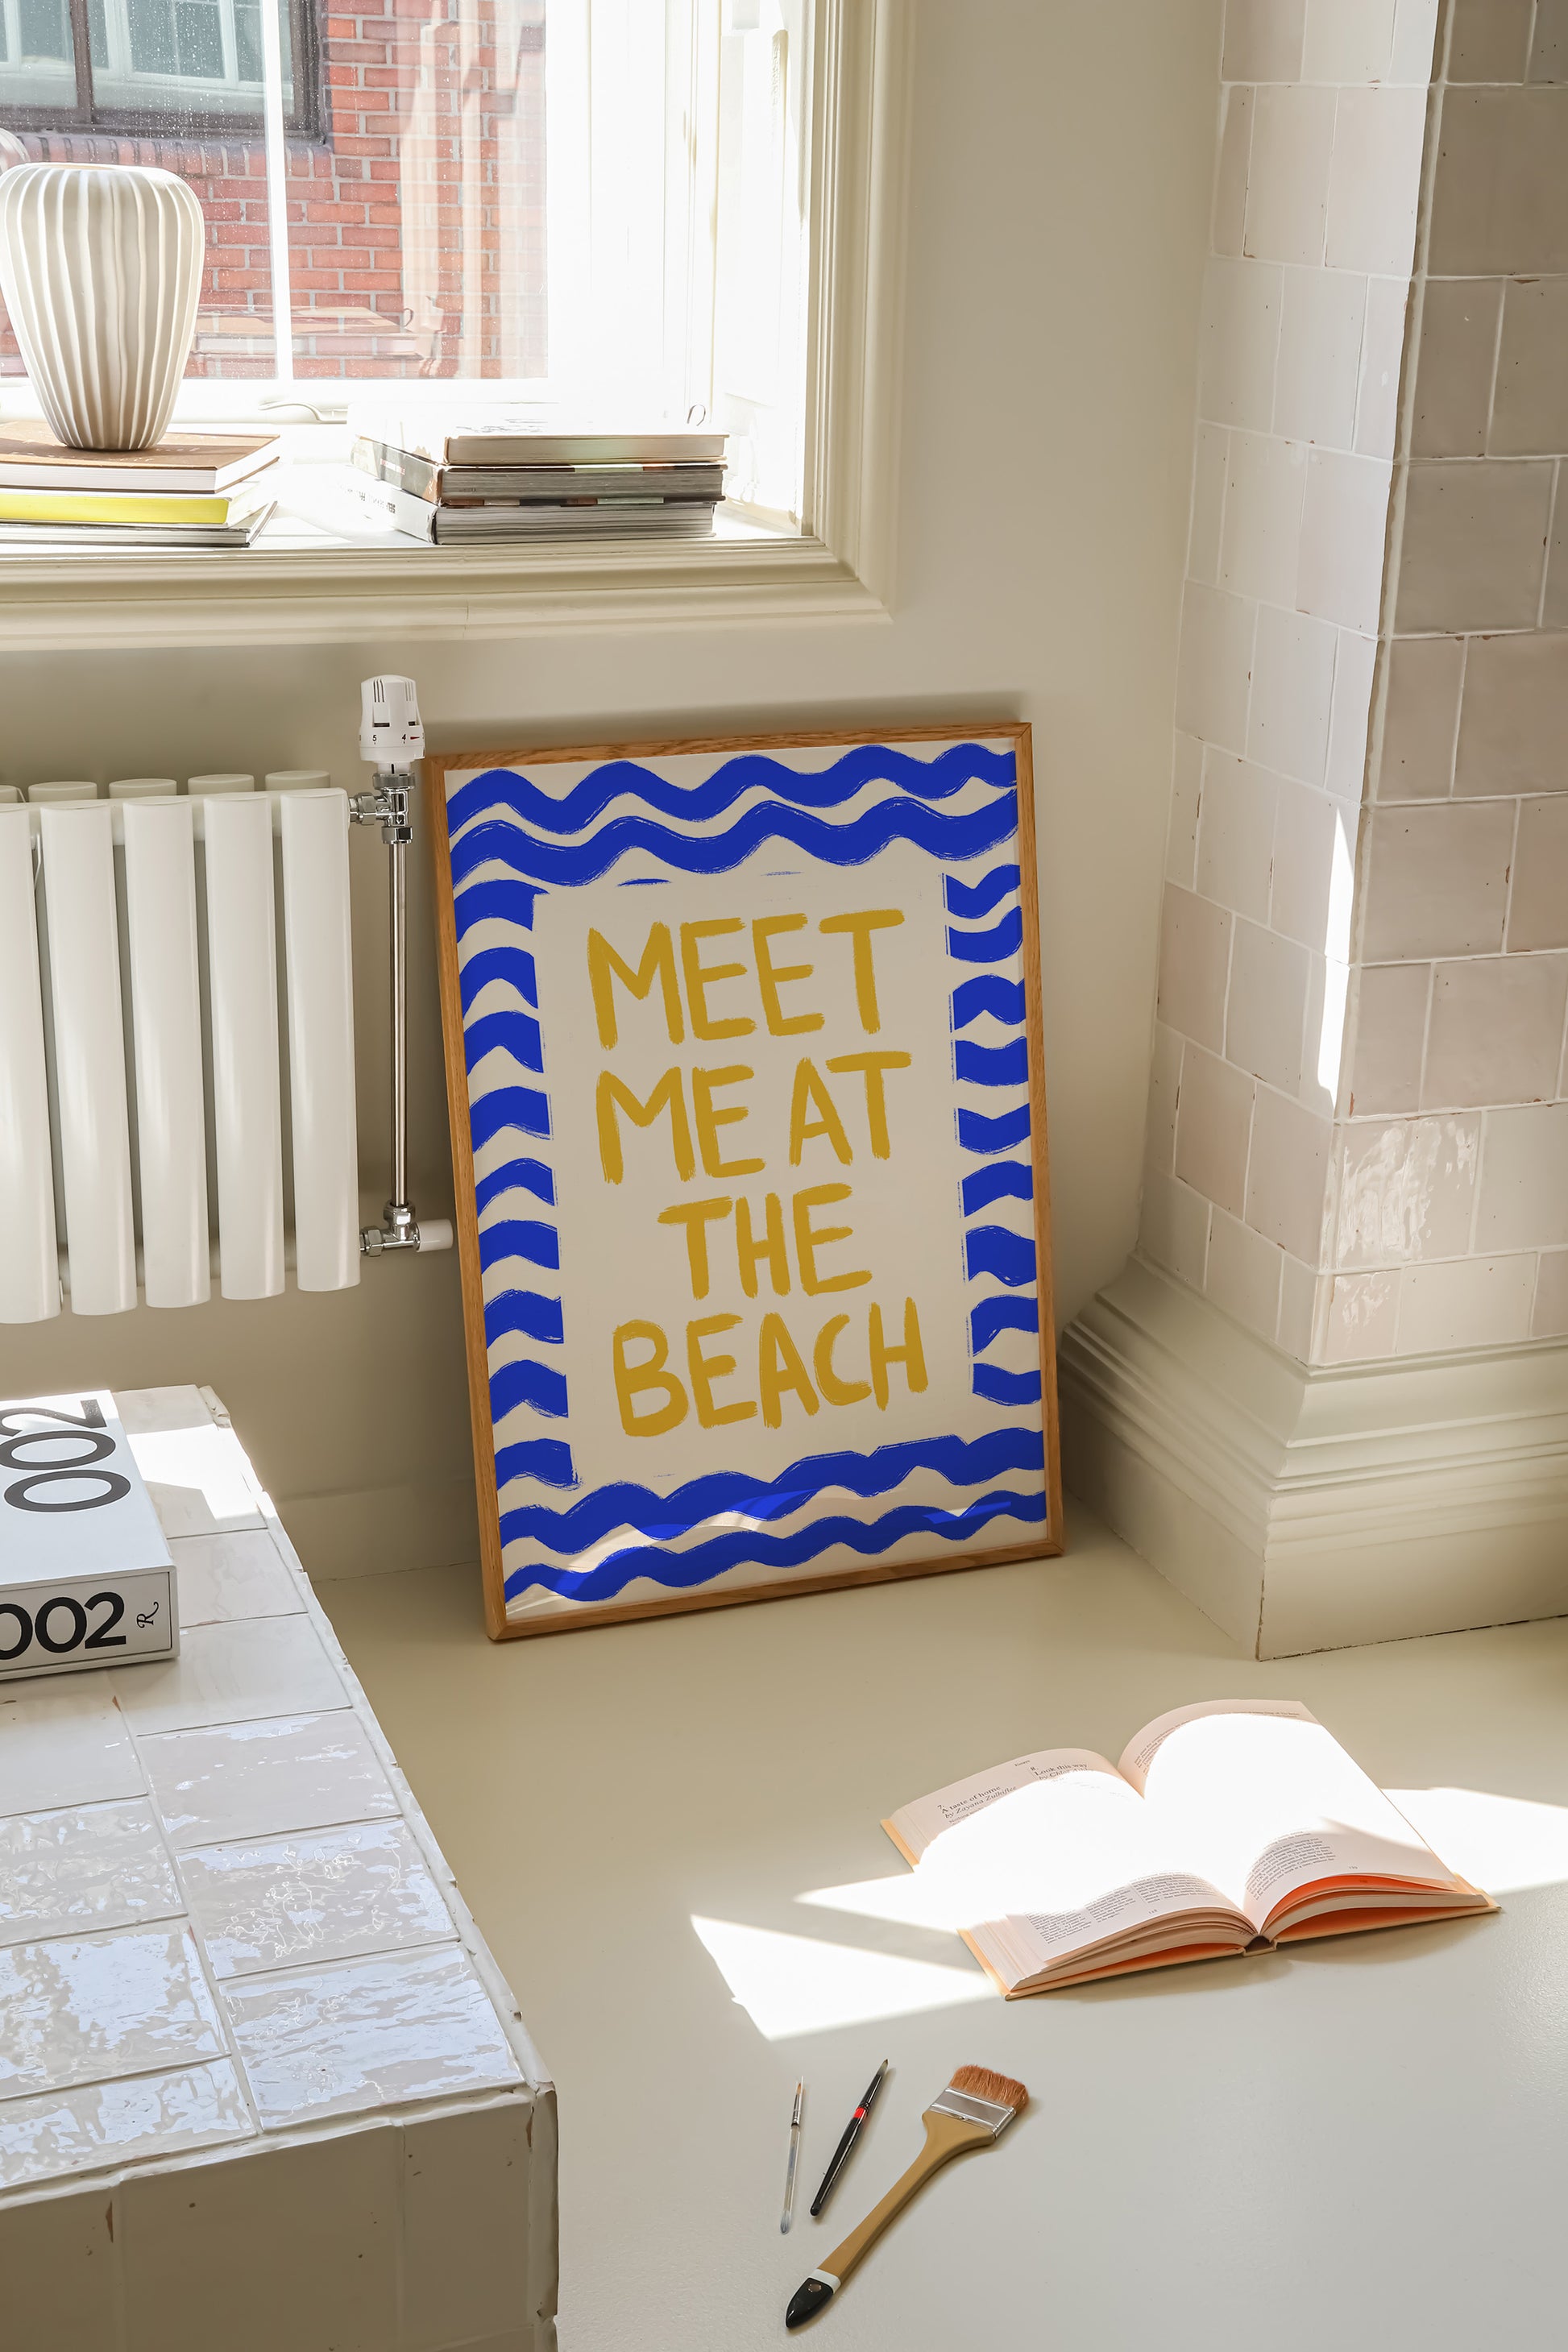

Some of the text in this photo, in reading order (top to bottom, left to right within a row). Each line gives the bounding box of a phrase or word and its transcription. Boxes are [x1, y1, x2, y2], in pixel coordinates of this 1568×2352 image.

[372, 733, 407, 742] 5 4
[587, 909, 905, 1050] MEET
[595, 1051, 912, 1185] ME AT
[657, 1182, 873, 1300] THE
[612, 1296, 929, 1437] BEACH
[0, 1399, 131, 1513] 002
[0, 1591, 127, 1660] 002
[949, 1798, 969, 1811] taste
[969, 1794, 977, 1802] of
[977, 1786, 1002, 1798] home
[1034, 1767, 1056, 1776] Look
